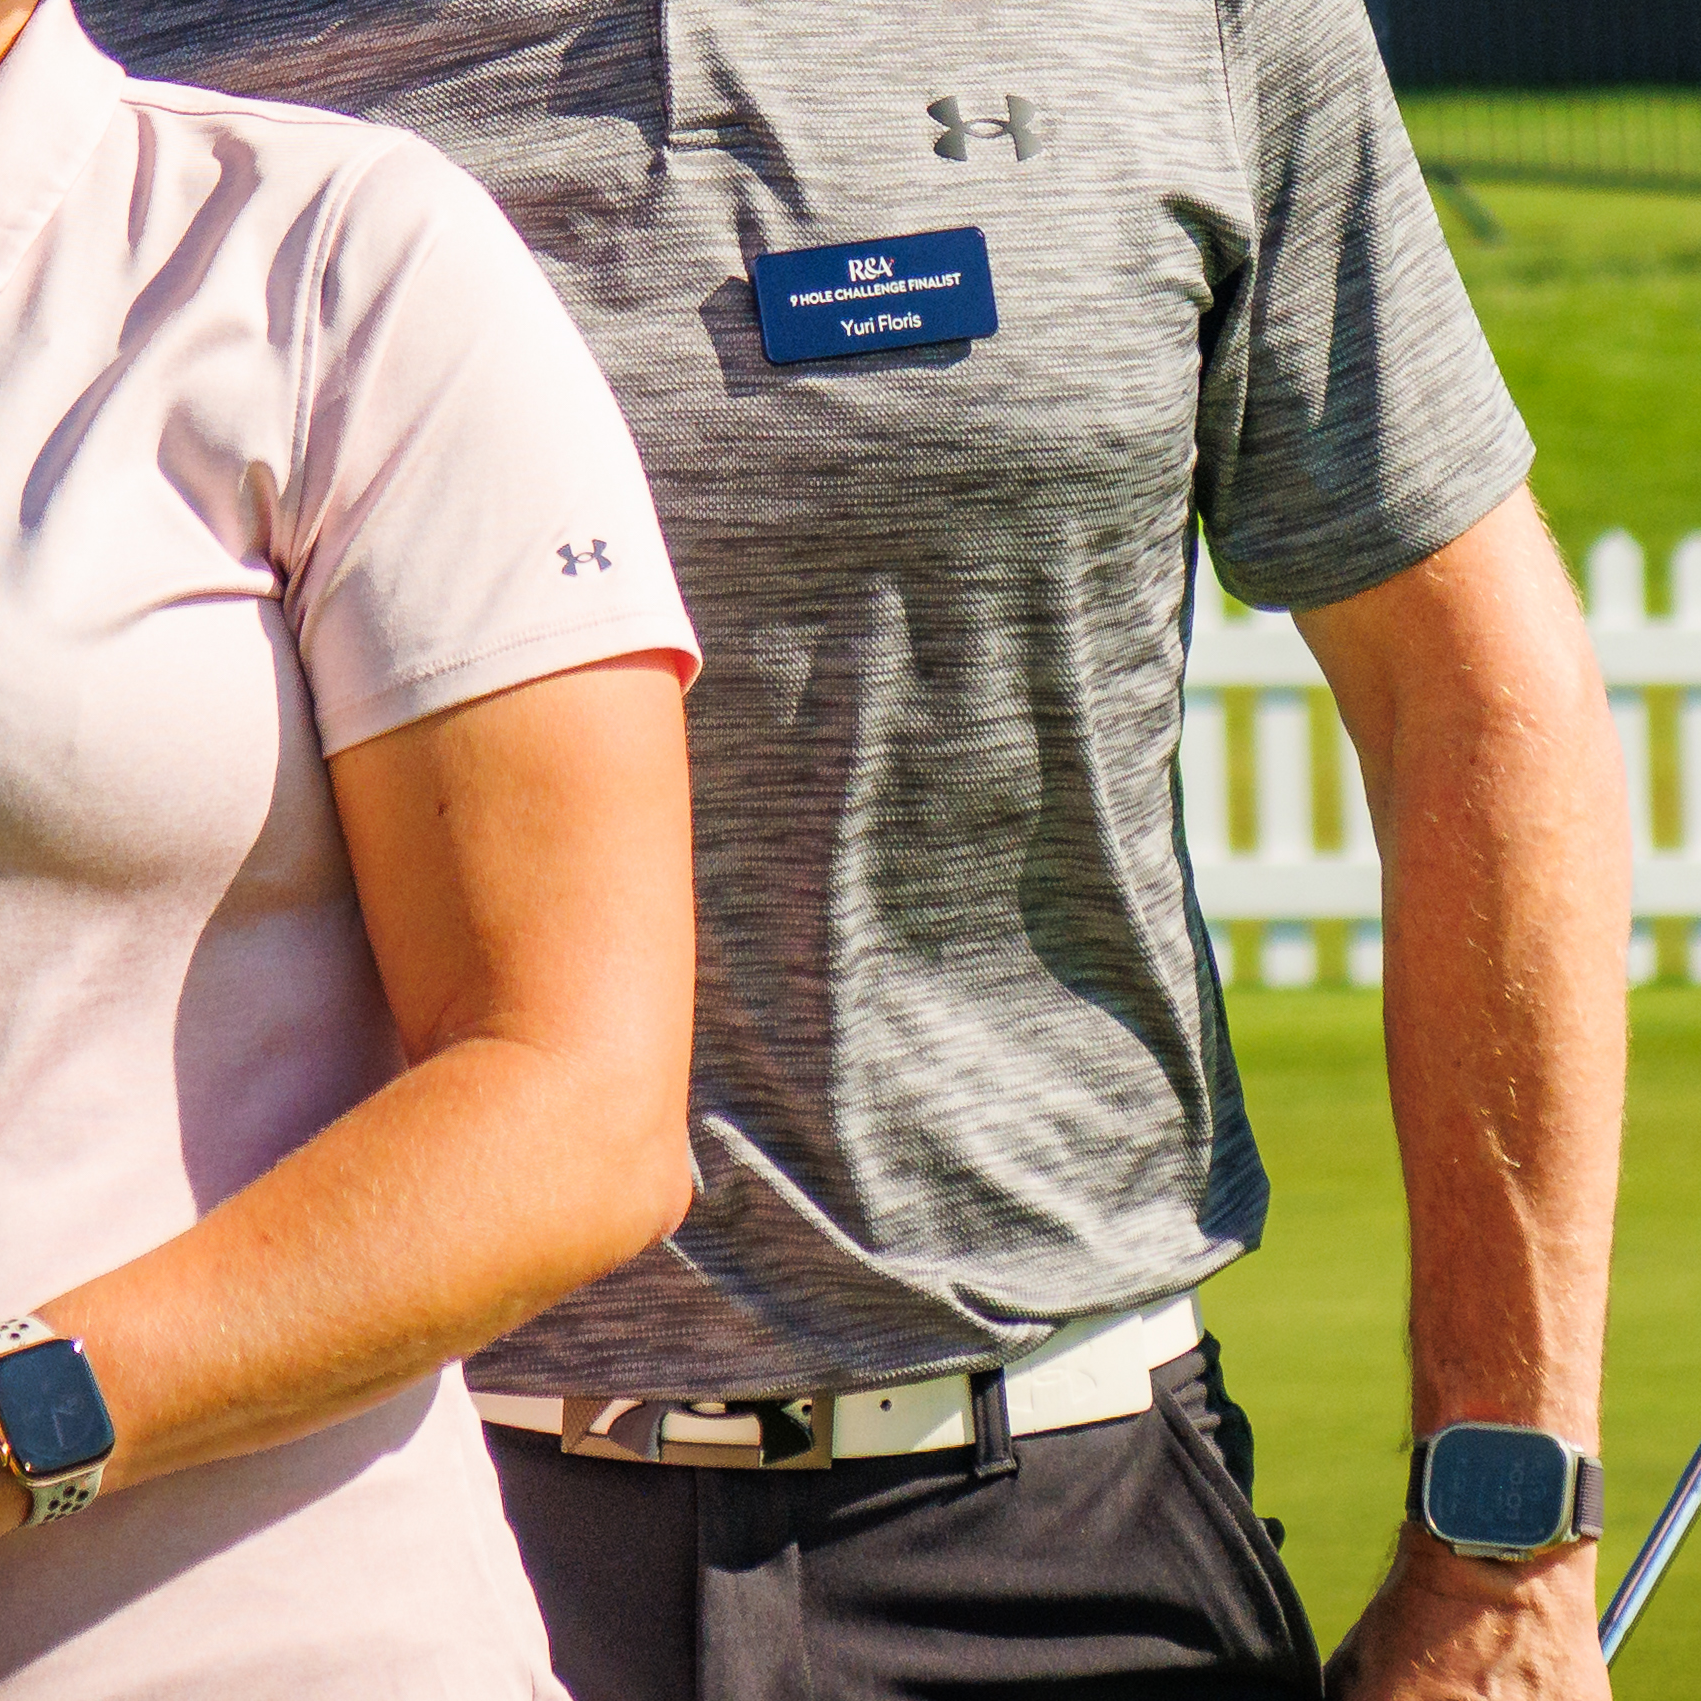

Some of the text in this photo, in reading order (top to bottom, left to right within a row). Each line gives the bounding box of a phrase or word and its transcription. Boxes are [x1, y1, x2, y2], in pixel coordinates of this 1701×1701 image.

[848, 256, 894, 282] R&A
[789, 272, 961, 308] 9 HOLE CHALLENGE FINALIST
[840, 311, 923, 337] Yuri Floris
